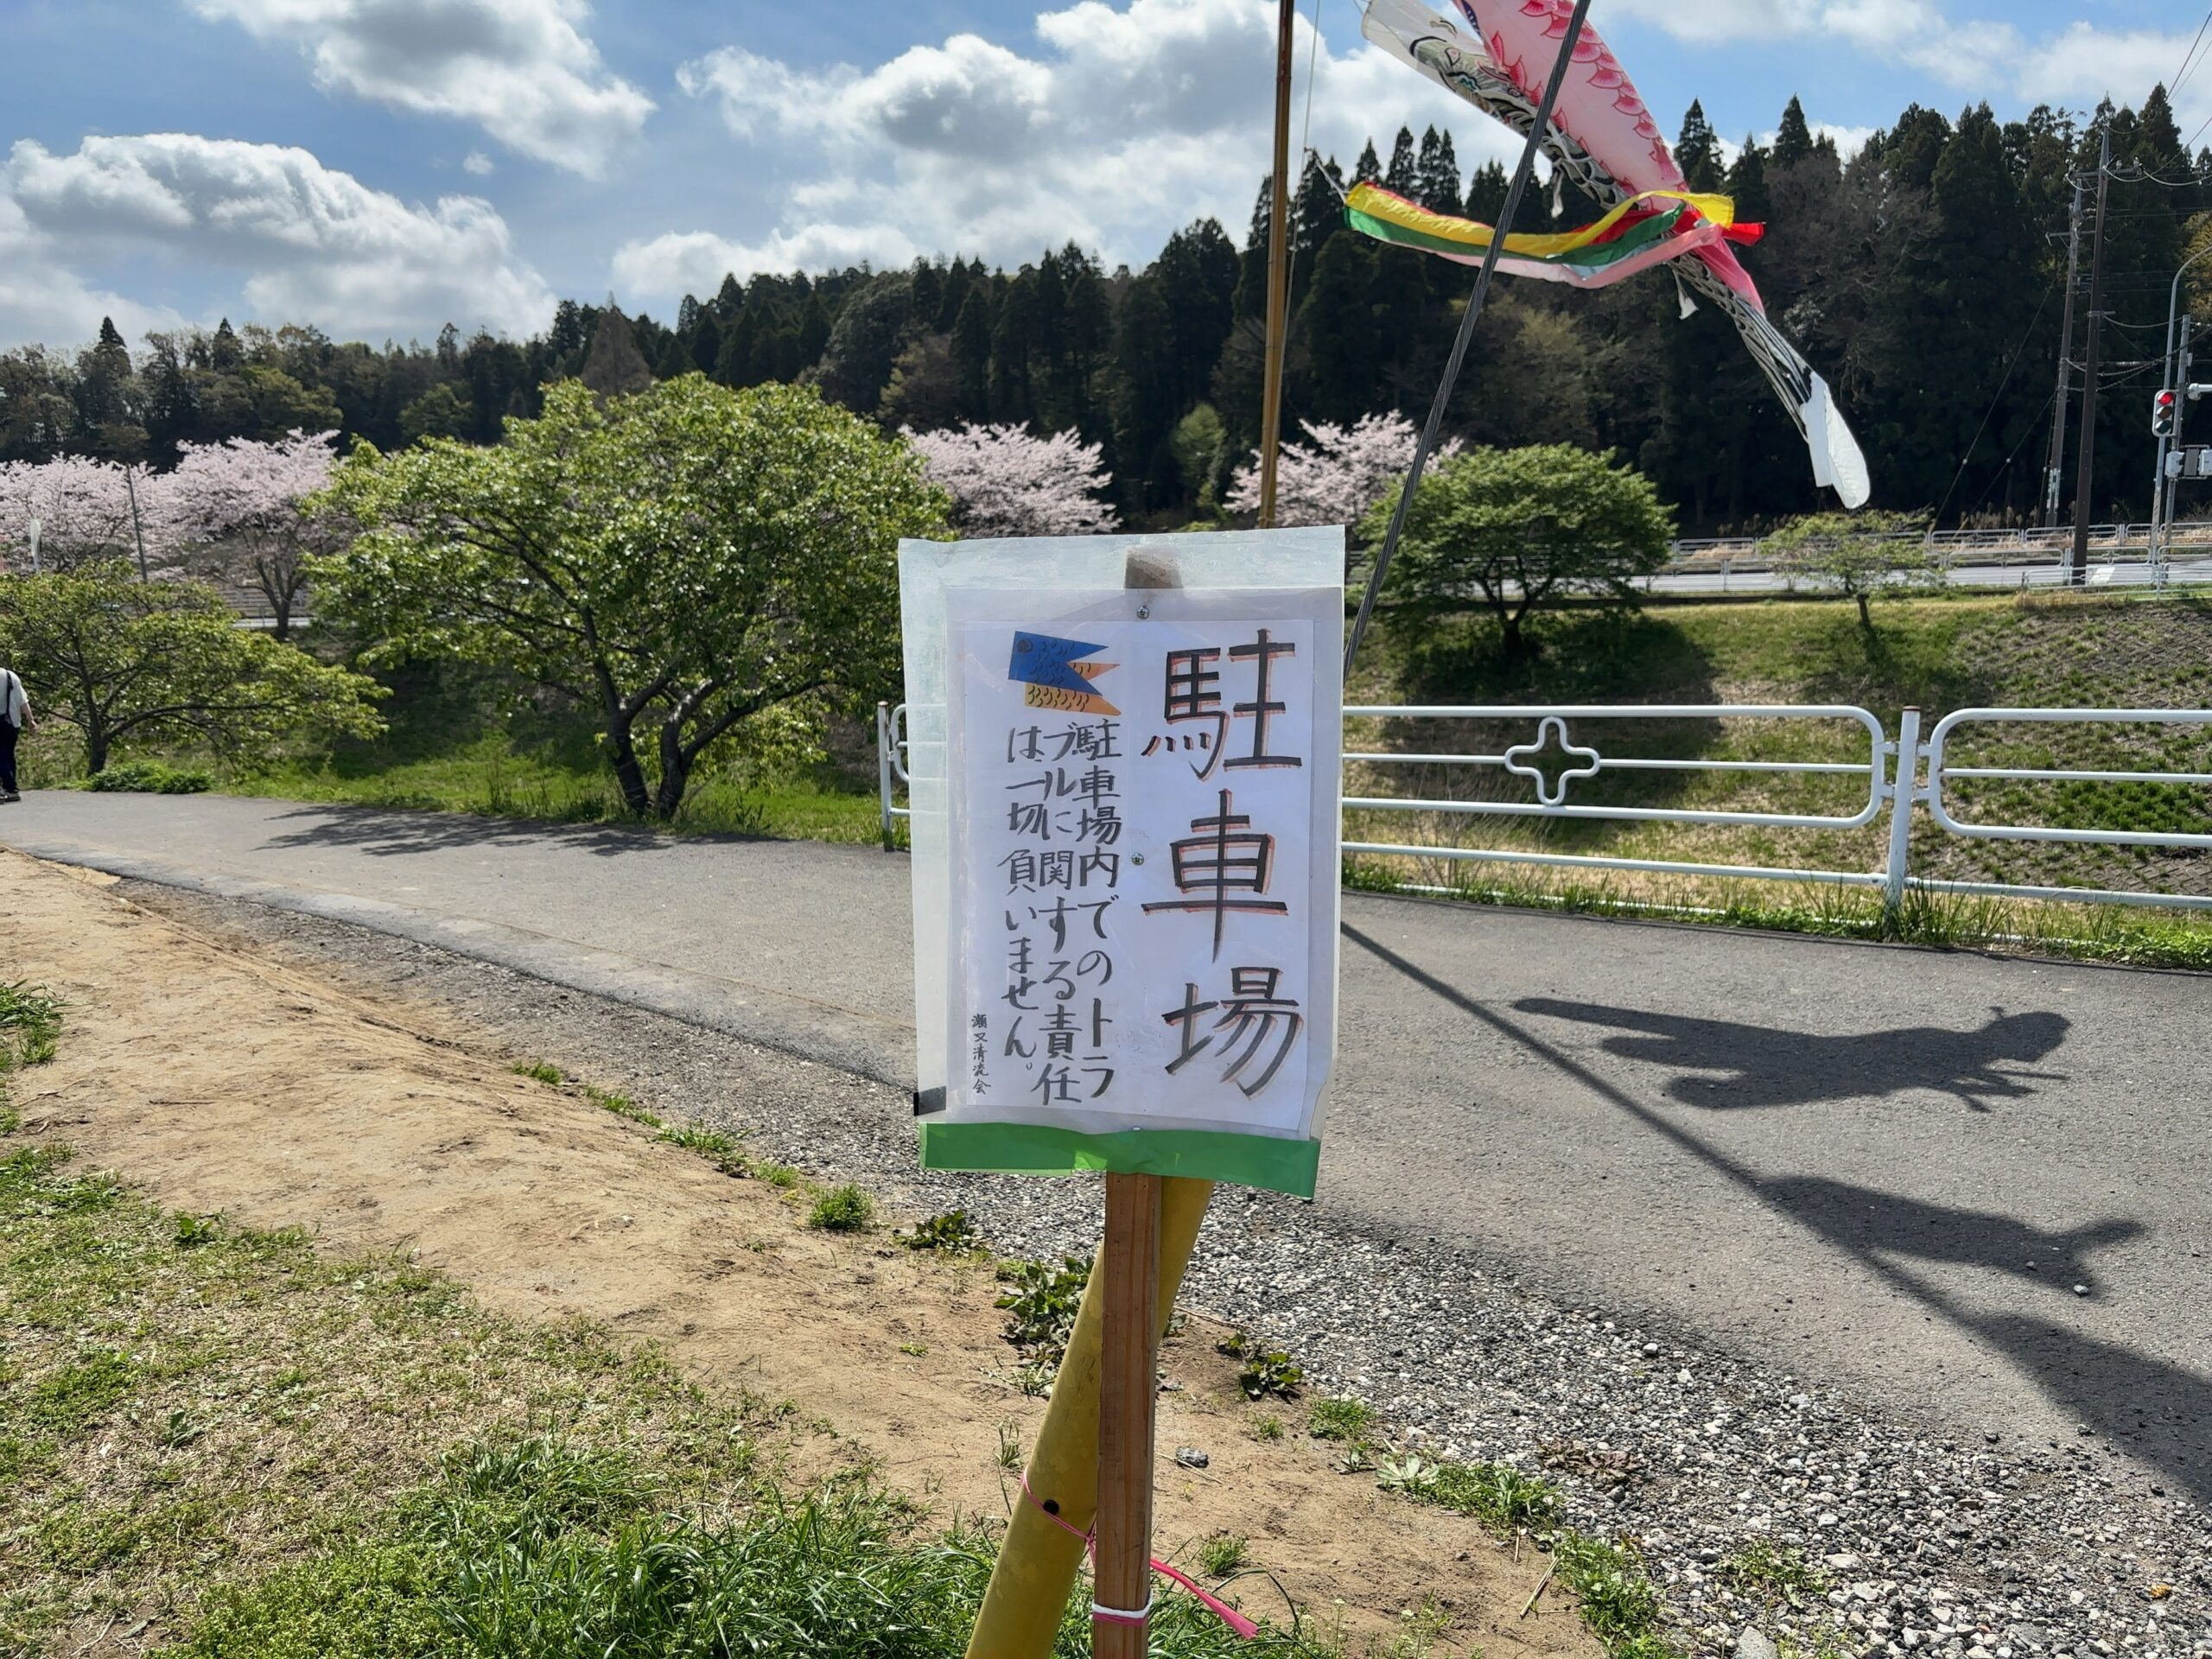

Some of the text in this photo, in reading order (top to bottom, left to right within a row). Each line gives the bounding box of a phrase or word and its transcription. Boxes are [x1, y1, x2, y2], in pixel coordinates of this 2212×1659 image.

[1030, 721, 1082, 1105] ブルに関する責任
[1072, 718, 1122, 1098] 駐車場内でのトラ
[1140, 628, 1303, 1100] 駐車場
